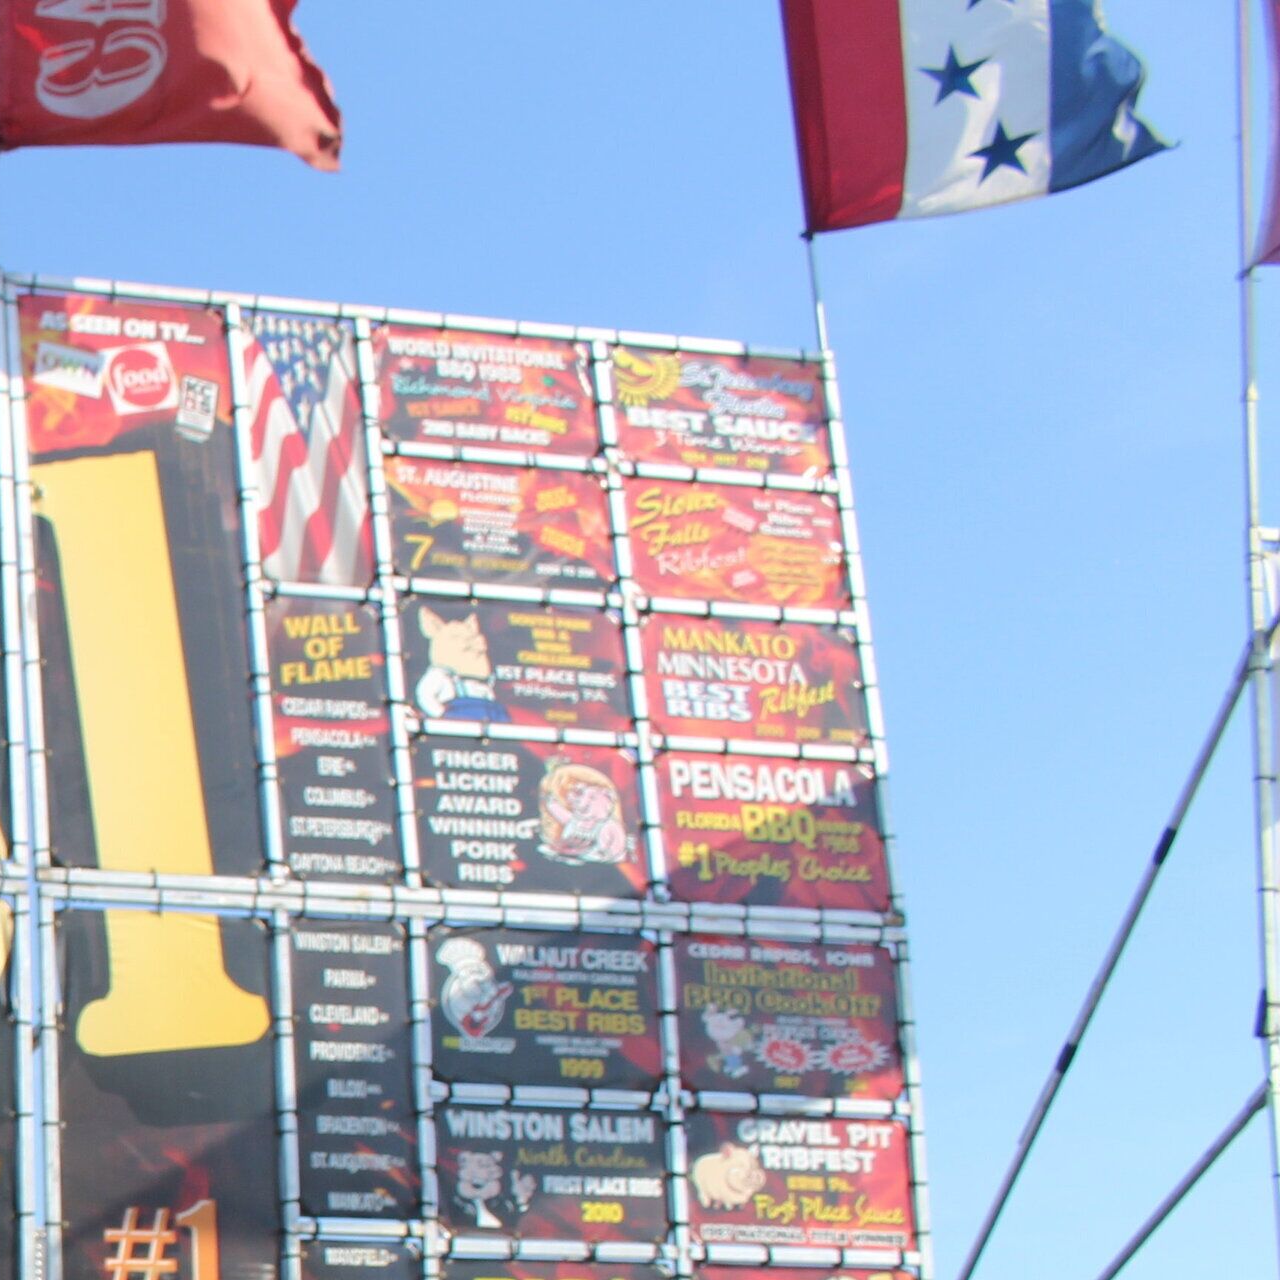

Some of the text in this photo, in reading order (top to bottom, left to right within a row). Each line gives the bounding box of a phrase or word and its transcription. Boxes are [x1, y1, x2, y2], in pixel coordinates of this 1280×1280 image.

[124, 316, 157, 339] ON
[115, 362, 170, 393] food
[627, 407, 816, 443] BEST SAUCE
[282, 611, 362, 639] WALL
[304, 635, 345, 660] OF
[663, 626, 796, 660] MANKATO
[280, 655, 374, 687] FLAME
[657, 651, 808, 686] MINNESOTA
[663, 680, 752, 703] BEST
[431, 749, 518, 772] FINGER
[668, 759, 857, 807] PENSACOLA
[437, 793, 522, 816] AWARD
[428, 815, 536, 841] WINNING
[740, 804, 816, 848] BBQ
[451, 838, 517, 861] PORK
[677, 841, 714, 882] #1
[457, 862, 515, 885] RIBS
[496, 943, 649, 973] WALNUT CREEK
[554, 987, 639, 1011] PLACE
[514, 1008, 646, 1035] BEST RIBS
[445, 1109, 654, 1144] WINSTON SALEM
[737, 1117, 894, 1148] GRAVEL PIT
[763, 1147, 877, 1174] RIBFEST
